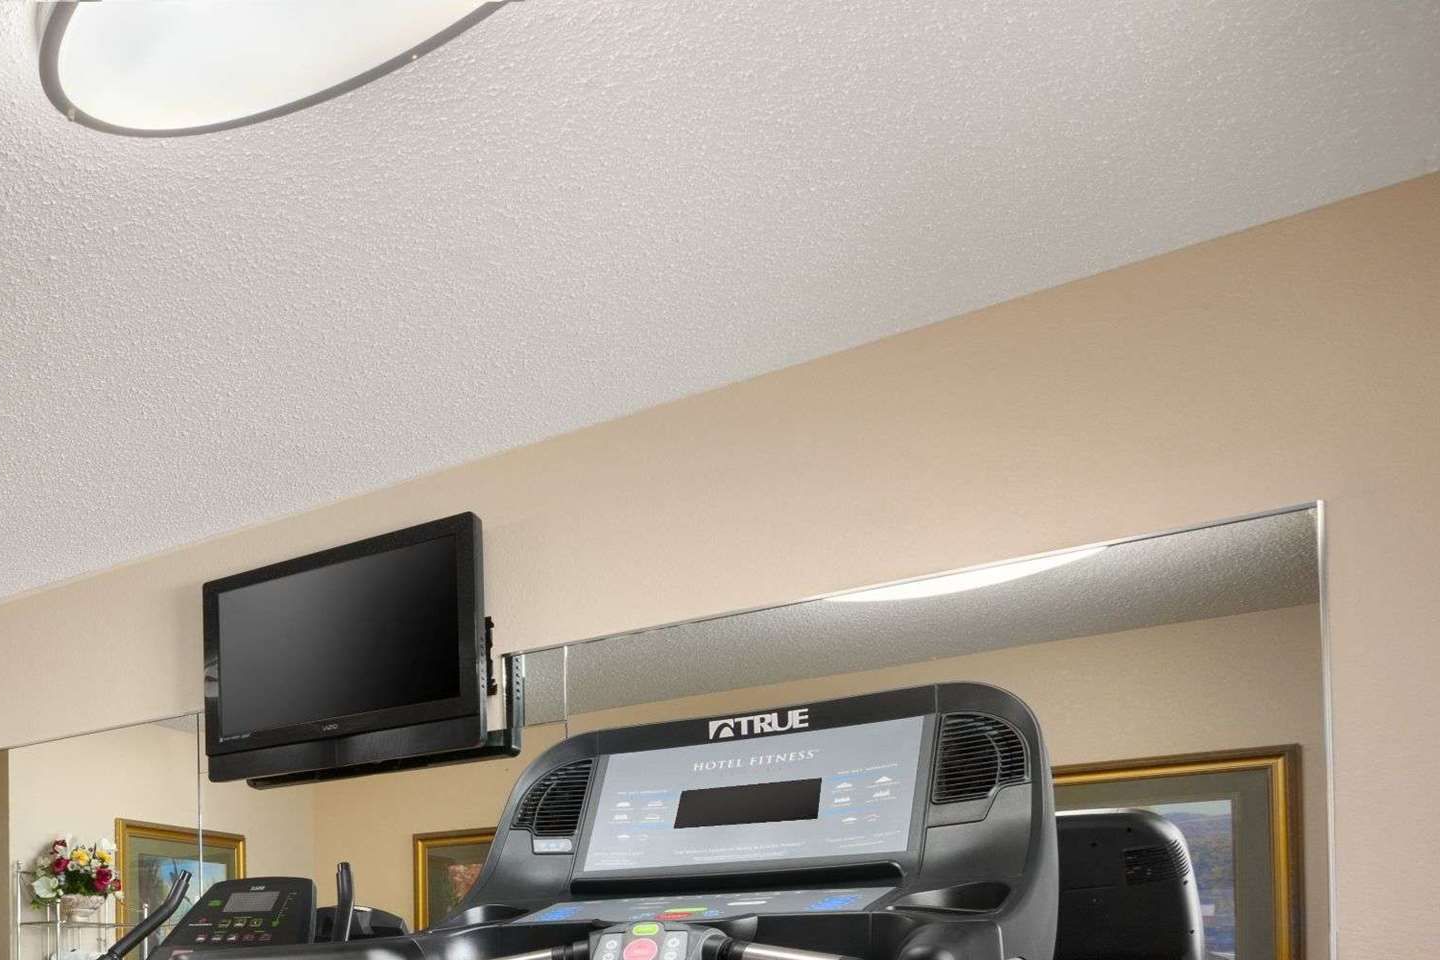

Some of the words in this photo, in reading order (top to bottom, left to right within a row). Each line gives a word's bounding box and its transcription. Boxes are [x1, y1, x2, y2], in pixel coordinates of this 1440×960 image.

[734, 708, 809, 735] TRUE
[693, 758, 743, 772] HOTEL
[750, 750, 816, 767] FITNESS
